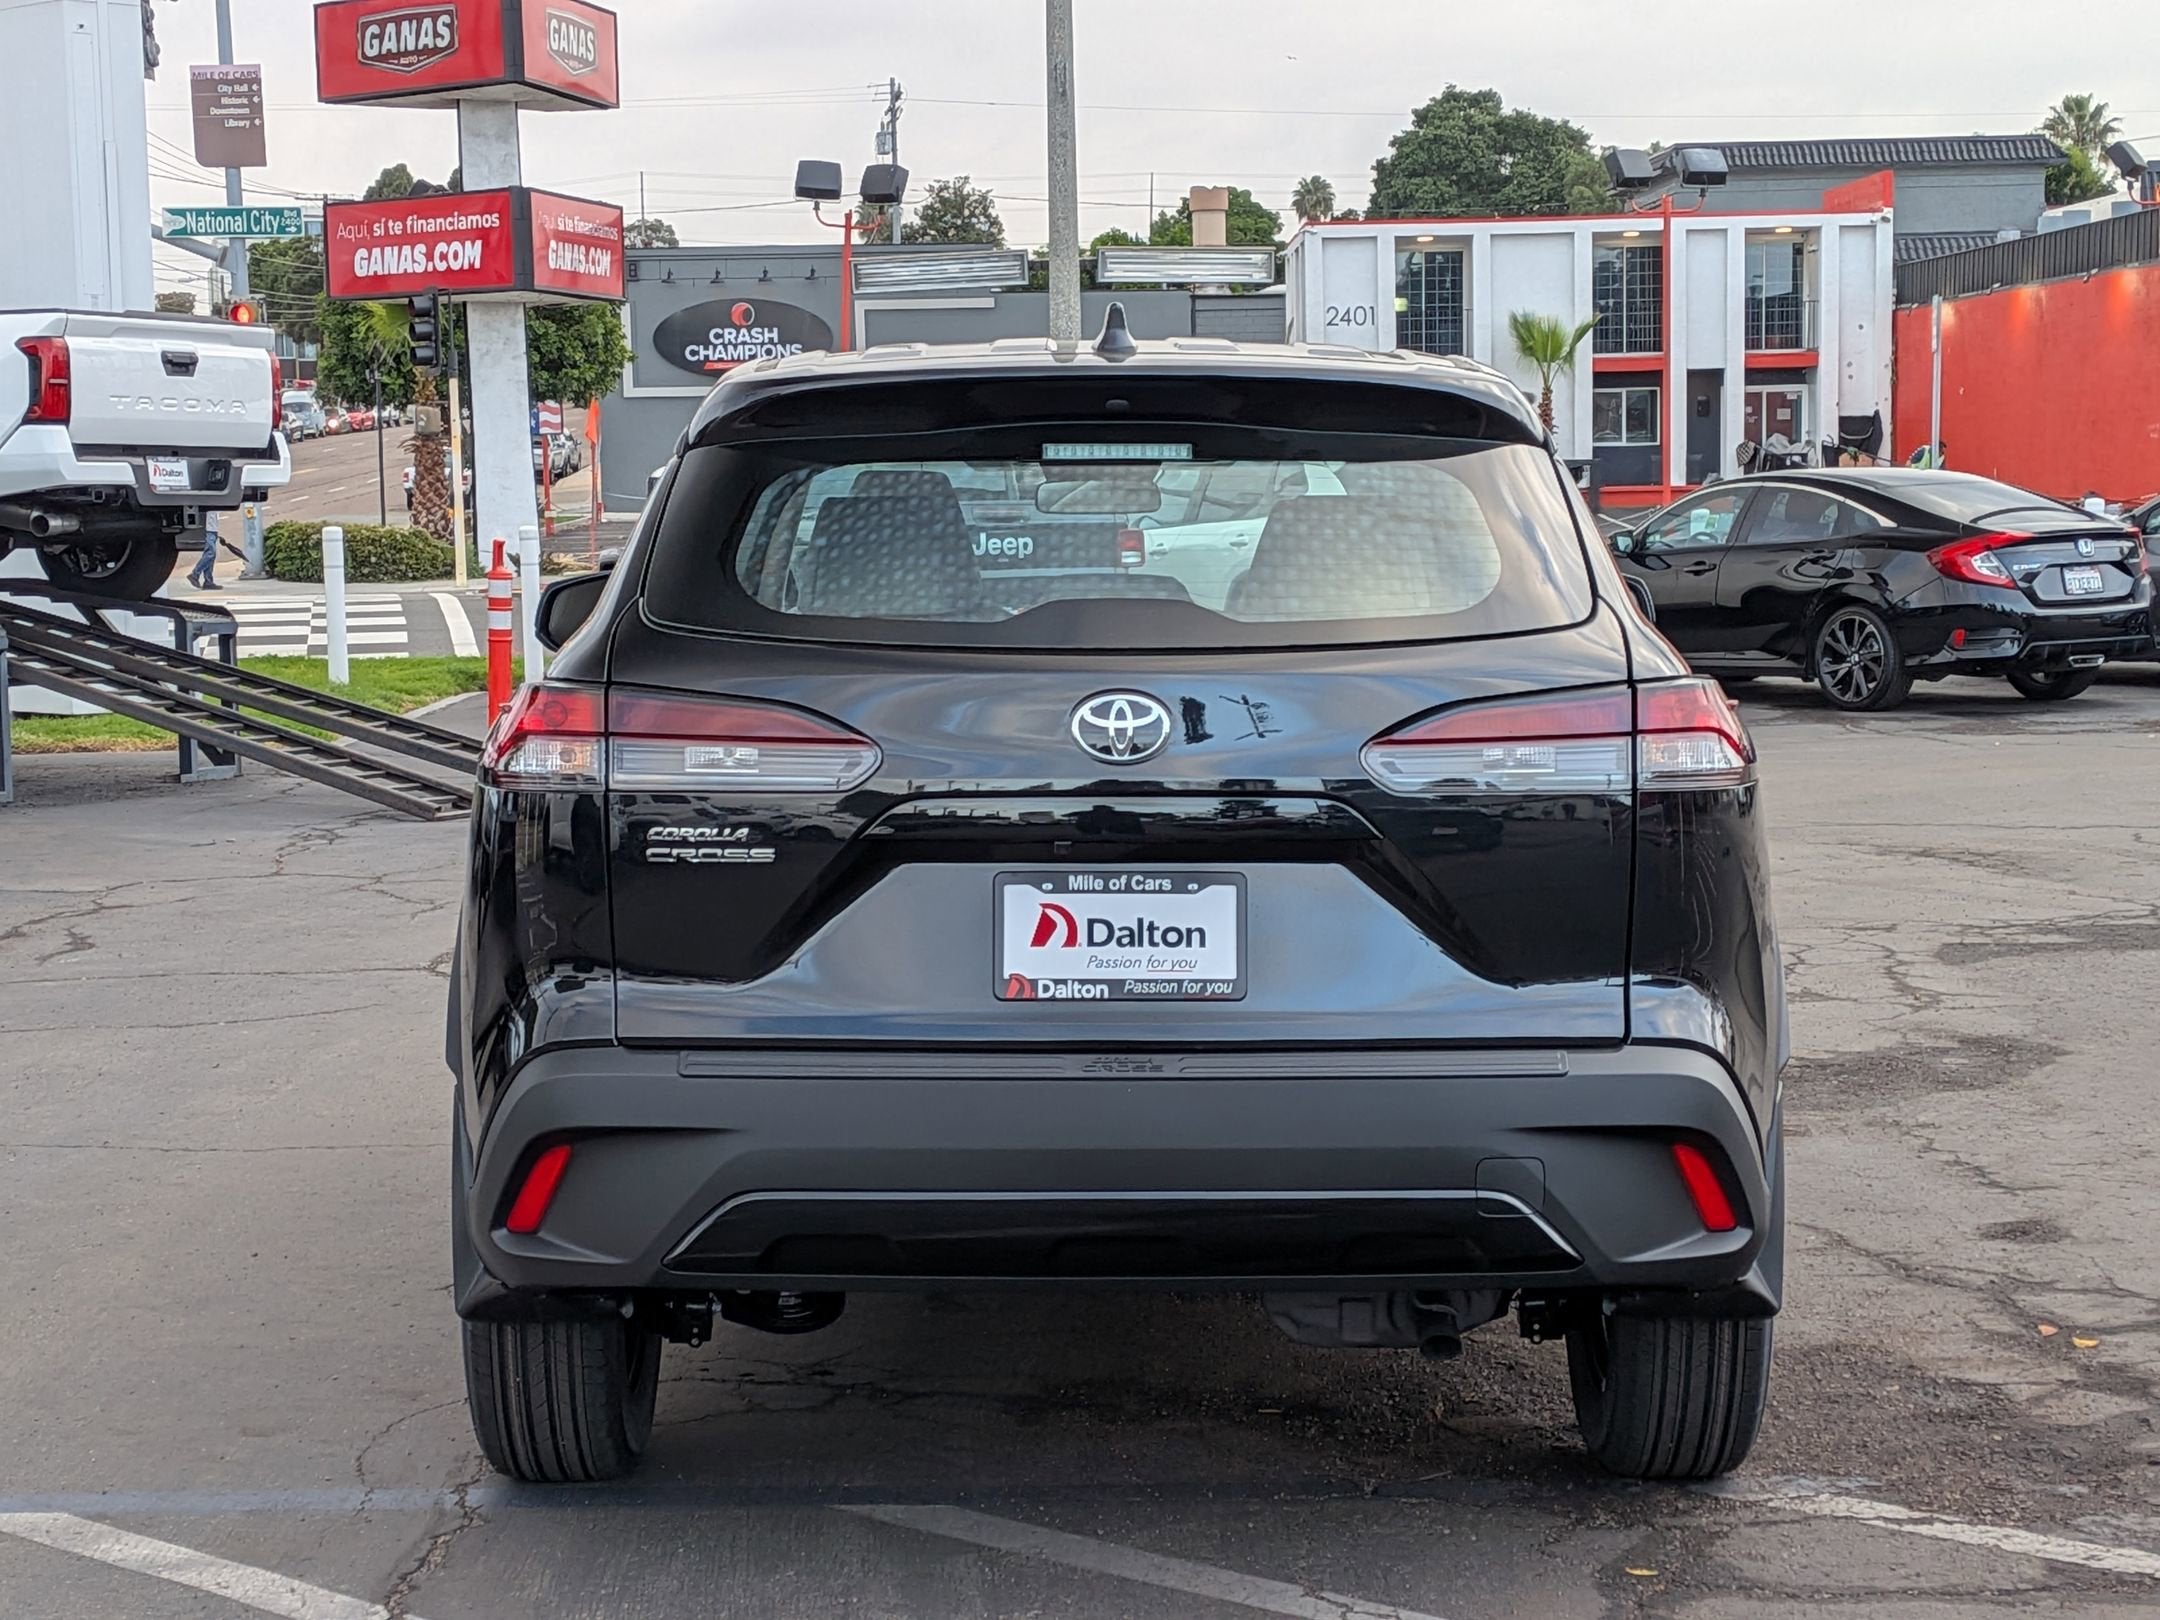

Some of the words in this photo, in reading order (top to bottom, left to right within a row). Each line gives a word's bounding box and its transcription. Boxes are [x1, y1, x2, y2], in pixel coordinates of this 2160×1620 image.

[363, 14, 452, 57] GANAS
[550, 18, 595, 62] GANAS
[192, 71, 215, 80] MILE
[217, 71, 229, 80] OF
[232, 71, 258, 80] CARS
[224, 118, 250, 129] Library
[185, 210, 247, 234] National
[250, 209, 280, 234] City
[372, 216, 386, 237] sí
[387, 218, 403, 236] te
[405, 210, 500, 235] financiamos
[354, 239, 482, 278] GANAS.COM
[548, 239, 612, 277] GANAS.COM
[1326, 305, 1375, 327] 2401
[708, 327, 779, 345] CRASH
[684, 343, 803, 361] CHAMPIONS
[109, 395, 248, 414] TACOMA
[971, 532, 1034, 559] Jeep
[646, 826, 750, 842] COROLLA
[645, 848, 776, 863] CROSS
[1068, 875, 1104, 891] Mile
[1108, 875, 1127, 891] of
[1131, 875, 1173, 891] Cars
[1086, 917, 1206, 949] Dalton
[1086, 955, 1142, 969] Passion
[1145, 955, 1168, 971] for
[1168, 958, 1198, 971] you
[1037, 980, 1109, 999] Dalton
[1123, 979, 1180, 994] Passion
[1182, 979, 1204, 995] for
[1203, 981, 1233, 996] you
